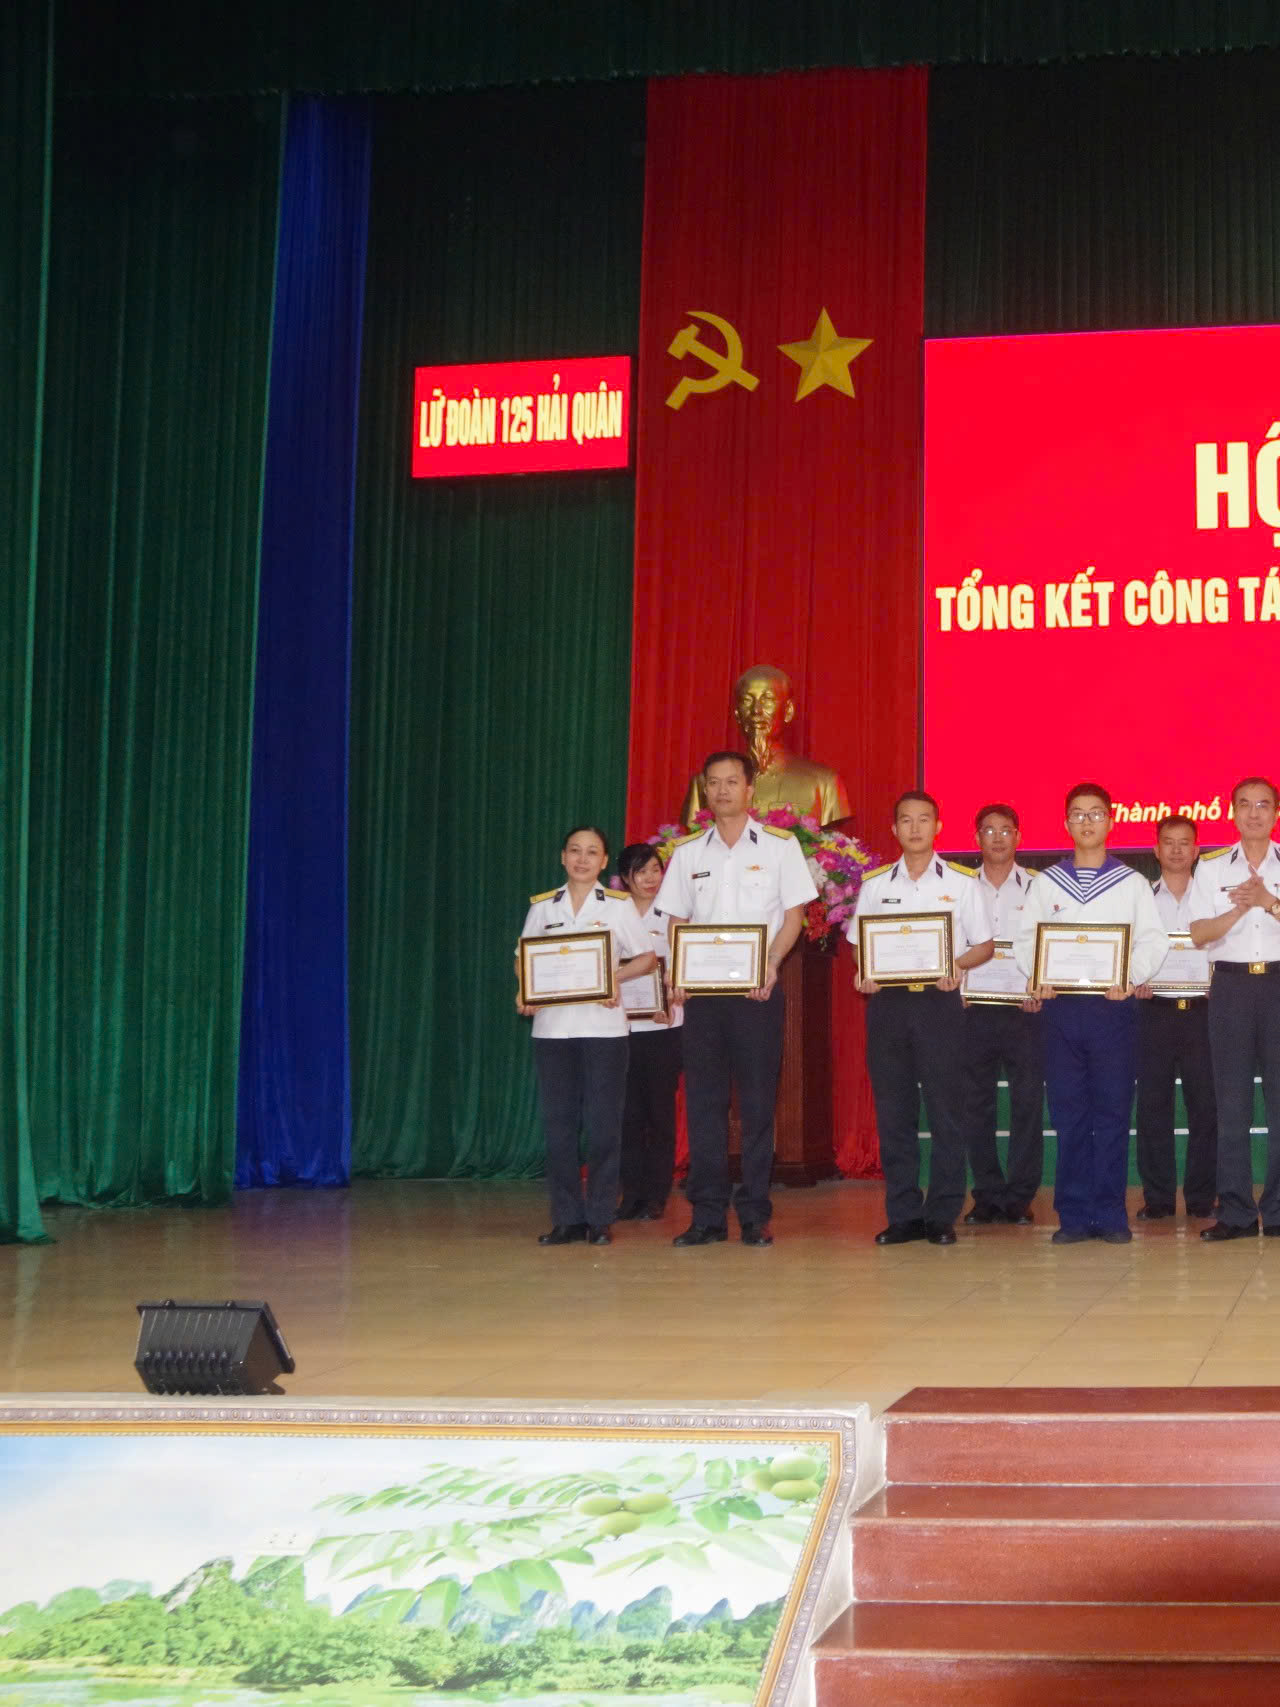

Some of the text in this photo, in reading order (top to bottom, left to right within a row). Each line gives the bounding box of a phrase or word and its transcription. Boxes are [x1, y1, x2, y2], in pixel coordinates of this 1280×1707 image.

[446, 388, 497, 447] ĐOÀN
[500, 396, 534, 444] 125
[536, 373, 569, 442] HẢI
[572, 381, 623, 445] QUÂN
[936, 568, 1034, 632] TỔNG
[1045, 566, 1115, 629] KẾT
[1124, 569, 1229, 626] CÔNG
